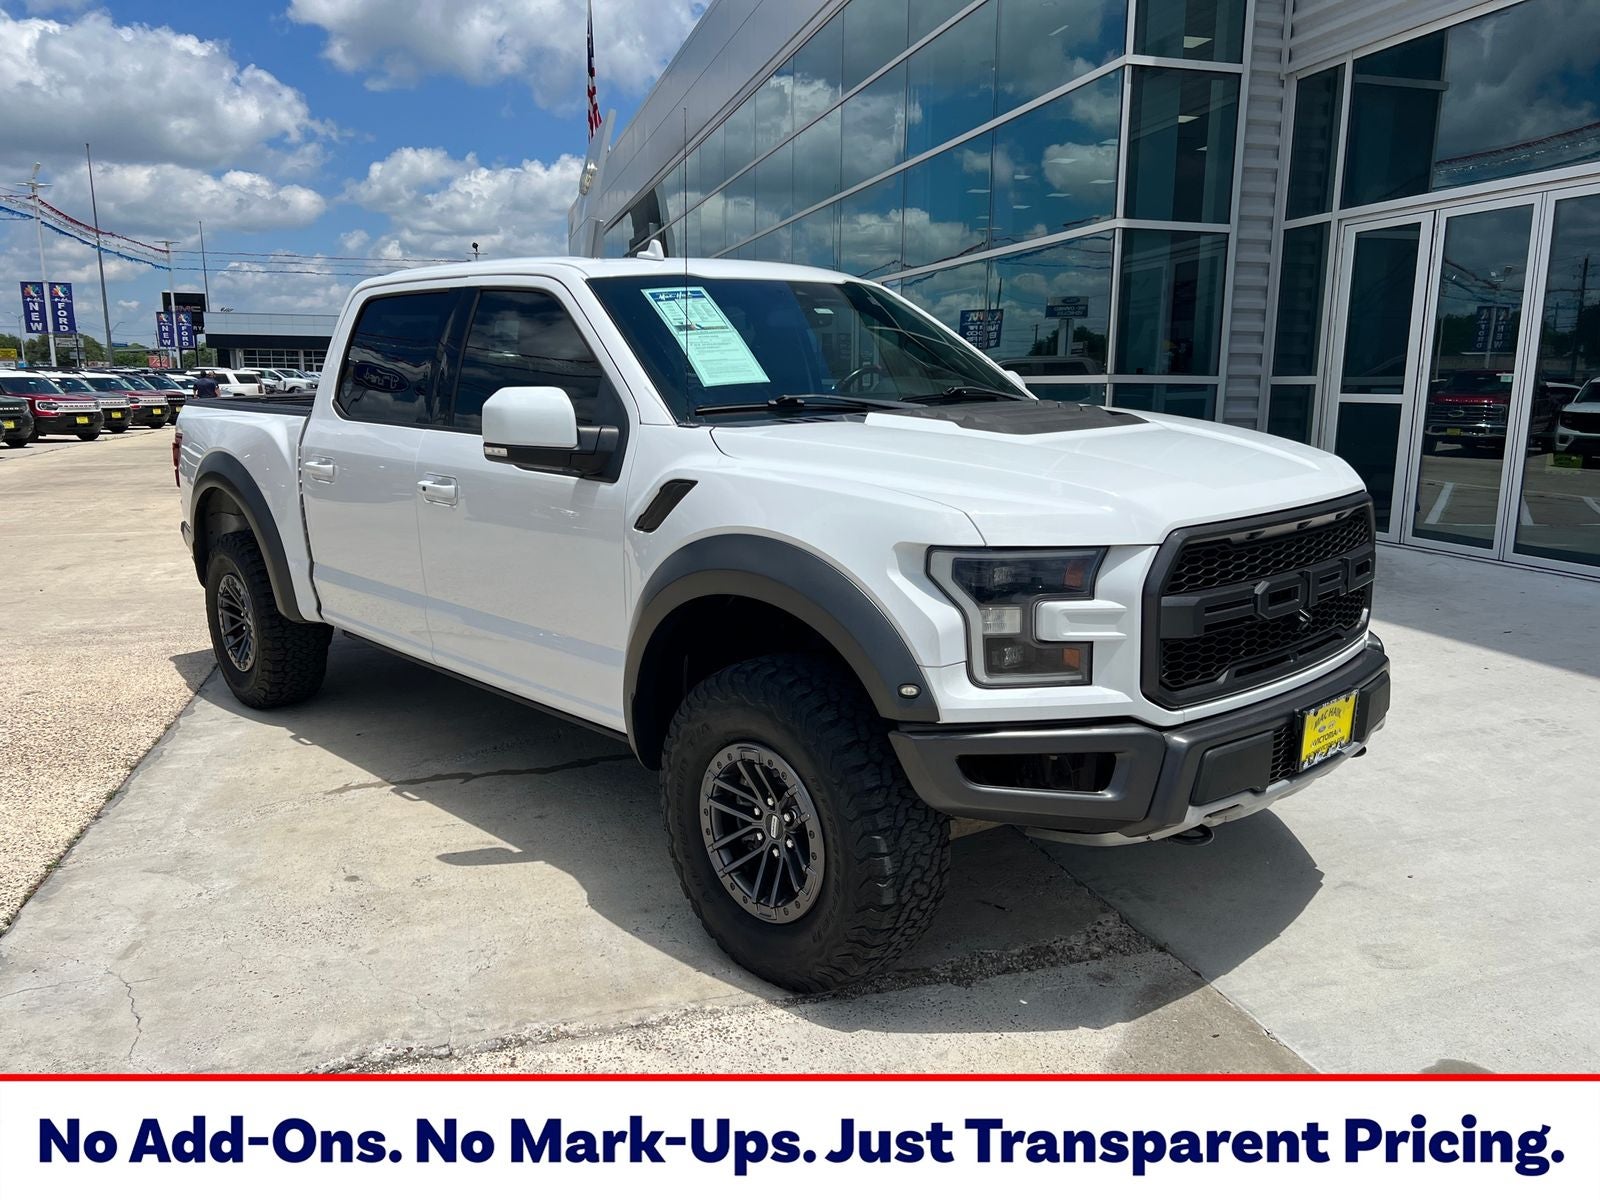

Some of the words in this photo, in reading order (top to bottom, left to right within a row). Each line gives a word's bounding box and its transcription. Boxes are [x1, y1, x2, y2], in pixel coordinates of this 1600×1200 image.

[29, 302, 43, 331] NEW
[57, 302, 69, 332] FORD
[161, 325, 171, 346] NEW
[181, 325, 190, 346] FORD
[1161, 551, 1376, 639] FORD
